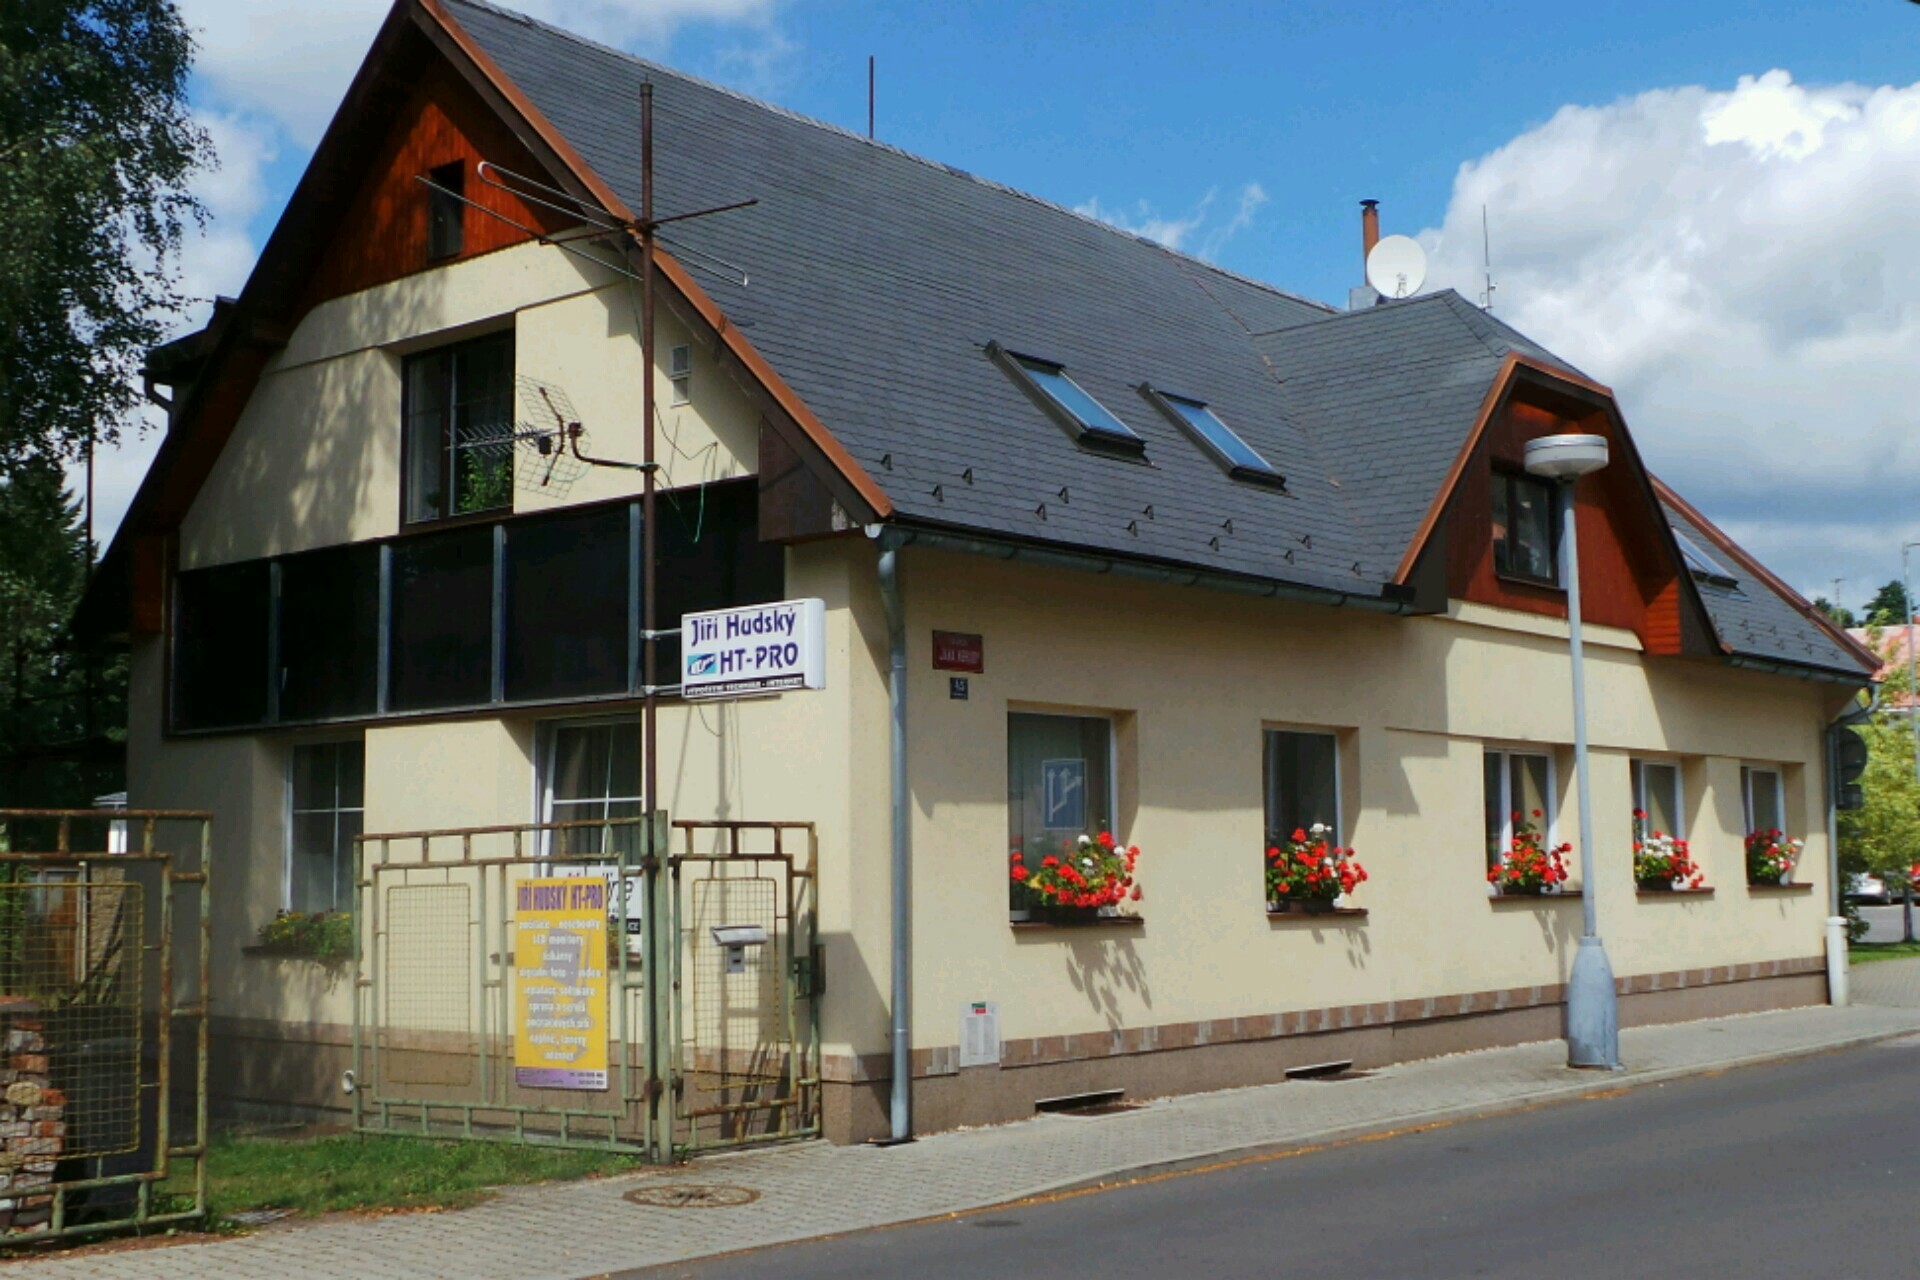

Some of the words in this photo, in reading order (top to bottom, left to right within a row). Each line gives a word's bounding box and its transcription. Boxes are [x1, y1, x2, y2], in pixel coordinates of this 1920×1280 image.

[691, 617, 718, 647] Jiří
[726, 608, 797, 640] Hudský
[720, 642, 799, 675] HT-PRO
[571, 884, 603, 910] HT-PRO
